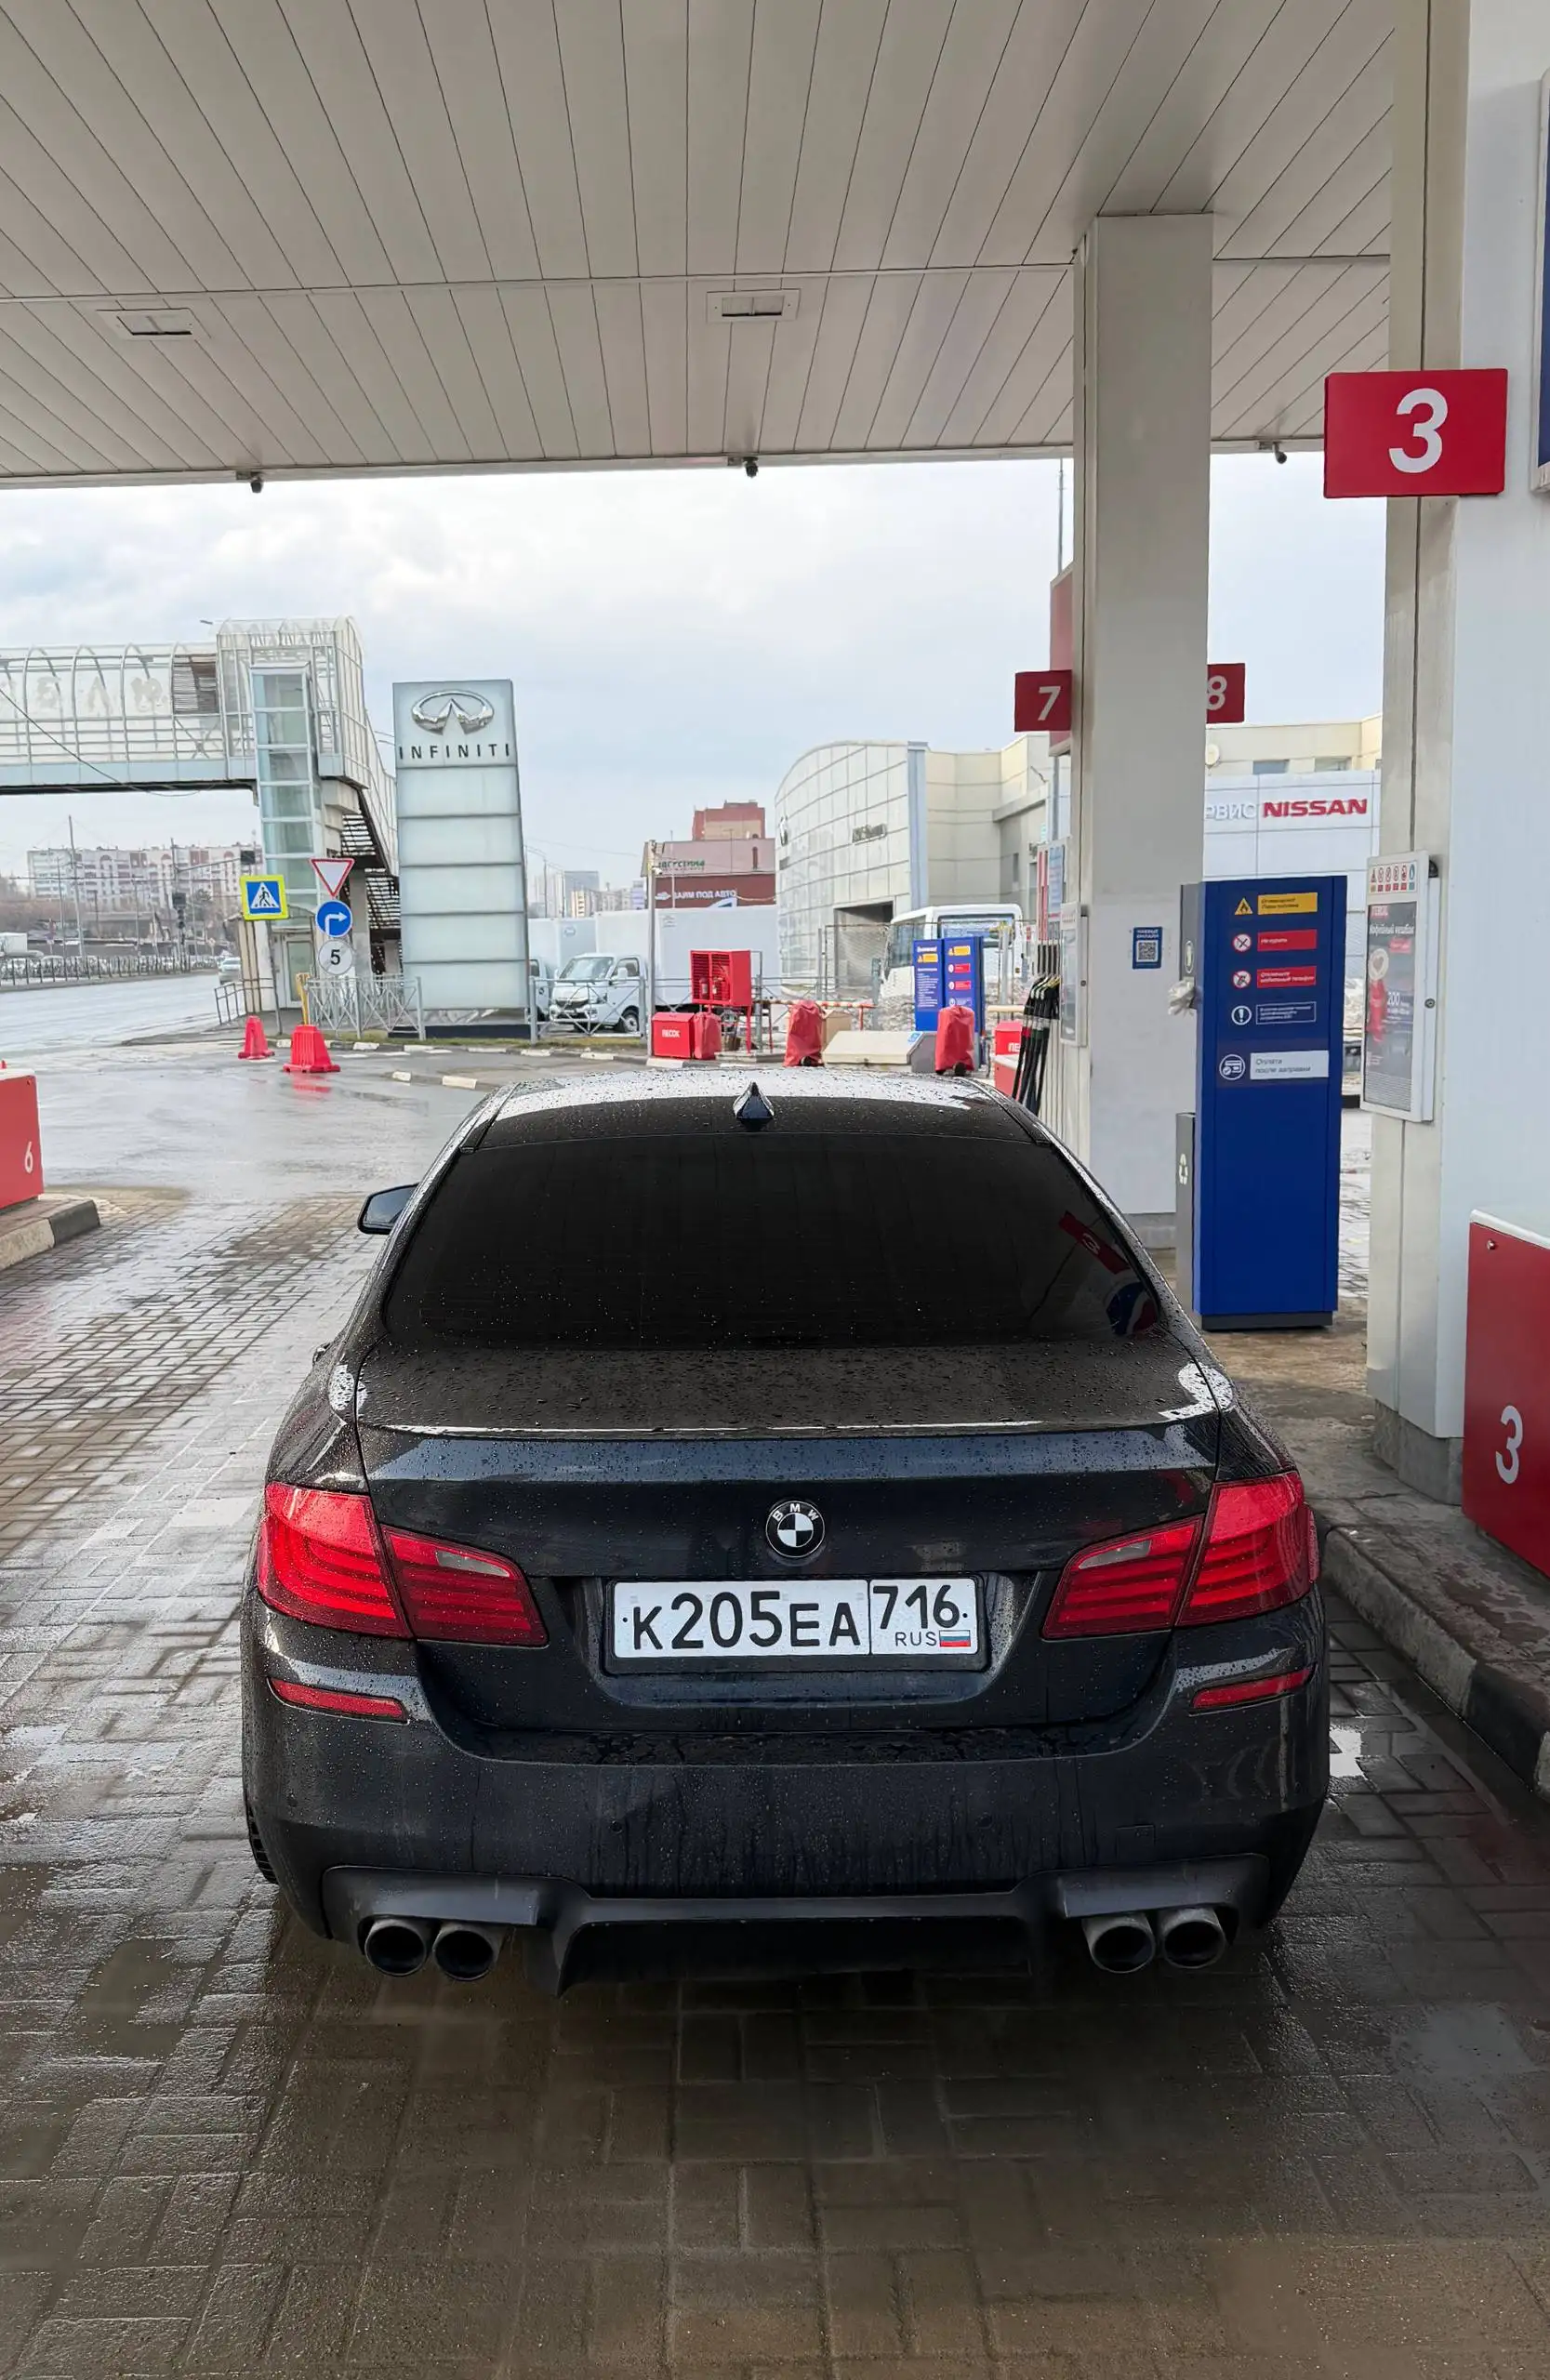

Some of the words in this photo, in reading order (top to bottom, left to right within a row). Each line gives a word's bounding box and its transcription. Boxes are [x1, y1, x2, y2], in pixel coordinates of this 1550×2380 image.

[1388, 388, 1448, 473] 3
[1038, 686, 1061, 721] 7
[1207, 675, 1227, 710] 8
[399, 743, 510, 760] INFINITI
[1263, 799, 1368, 818] NISSAN
[330, 949, 340, 965] 5
[1008, 1042, 1021, 1052] ПЕ
[24, 1141, 33, 1173] 6
[1495, 1405, 1523, 1484] 3
[772, 1503, 819, 1522] BMW
[632, 1591, 861, 1650] К205ЕА
[872, 1584, 960, 1629] 716
[894, 1632, 937, 1646] RUS
